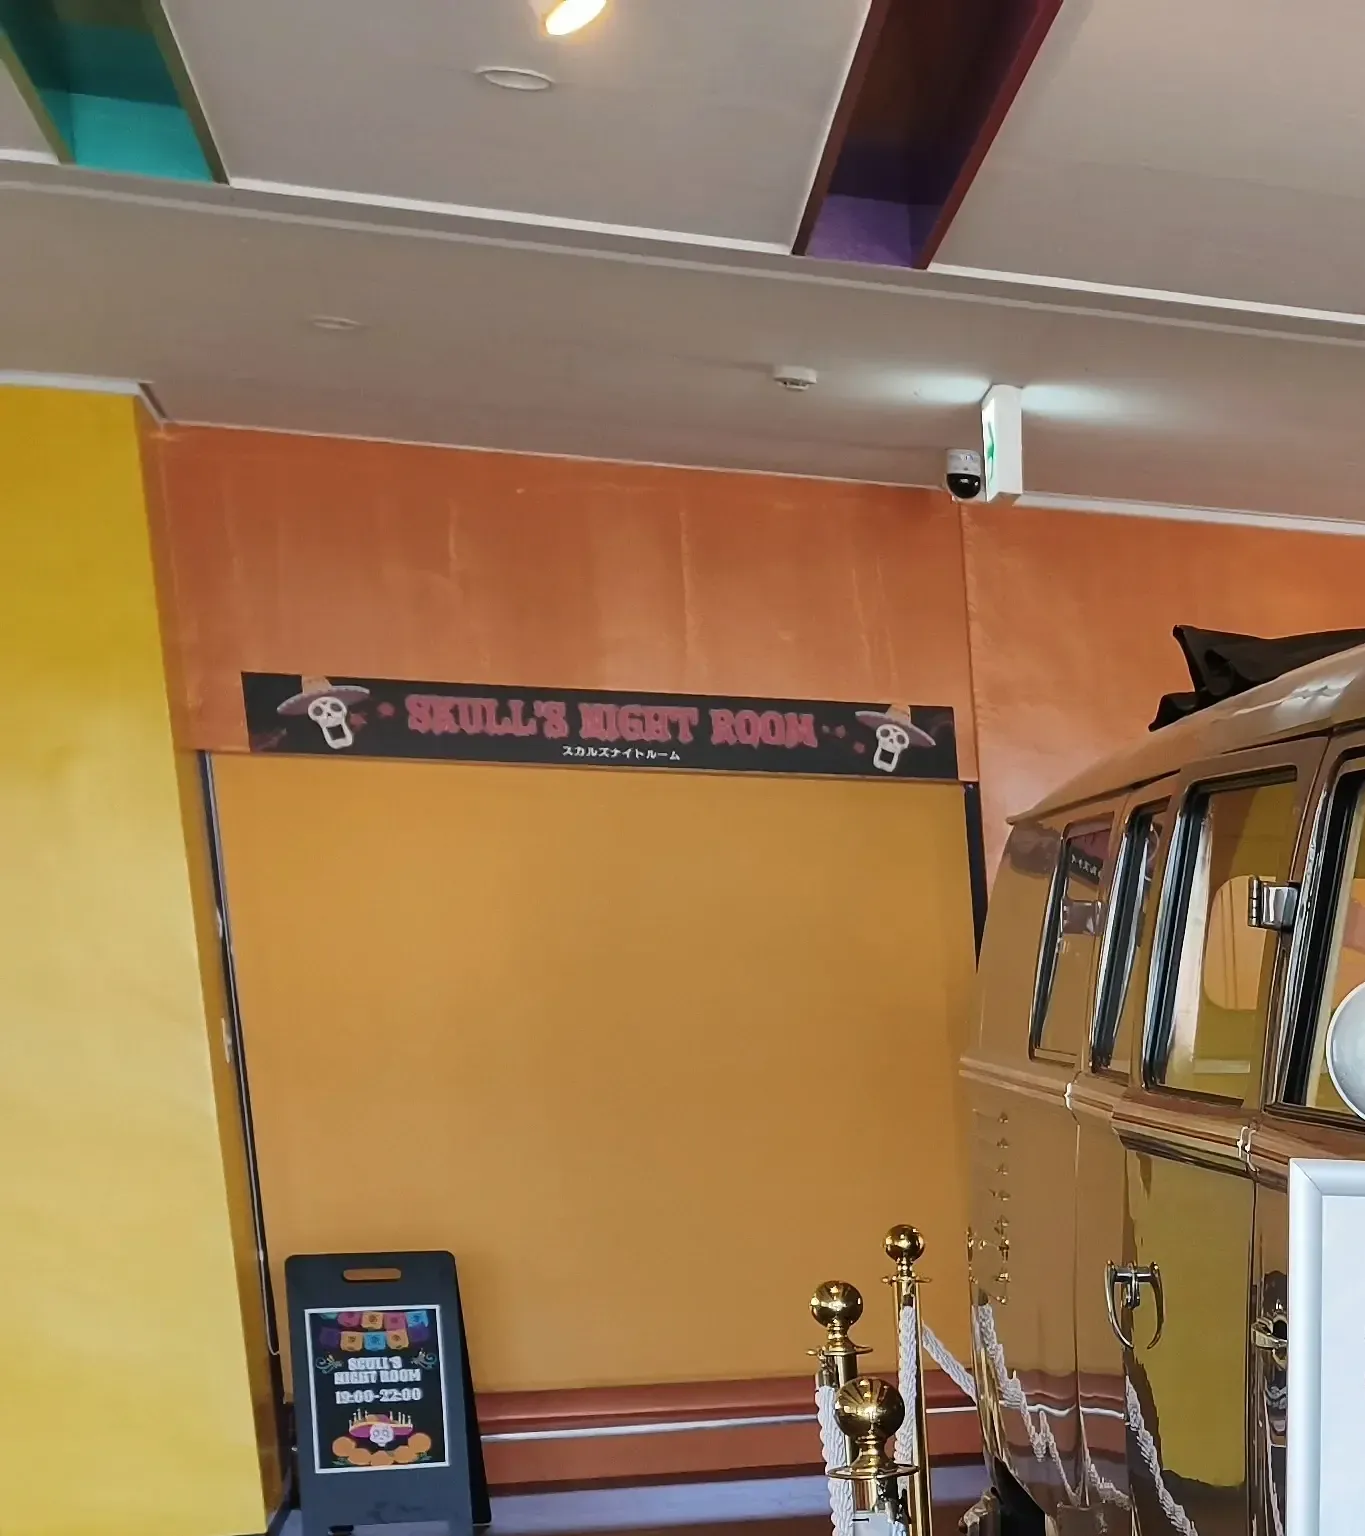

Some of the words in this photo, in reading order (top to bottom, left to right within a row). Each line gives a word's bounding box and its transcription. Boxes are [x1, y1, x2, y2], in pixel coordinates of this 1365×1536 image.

[404, 693, 570, 740] SKULL'S
[578, 702, 699, 745] NIGHT
[709, 708, 819, 750] ROOM
[562, 745, 681, 762] スカルズナイトルーム
